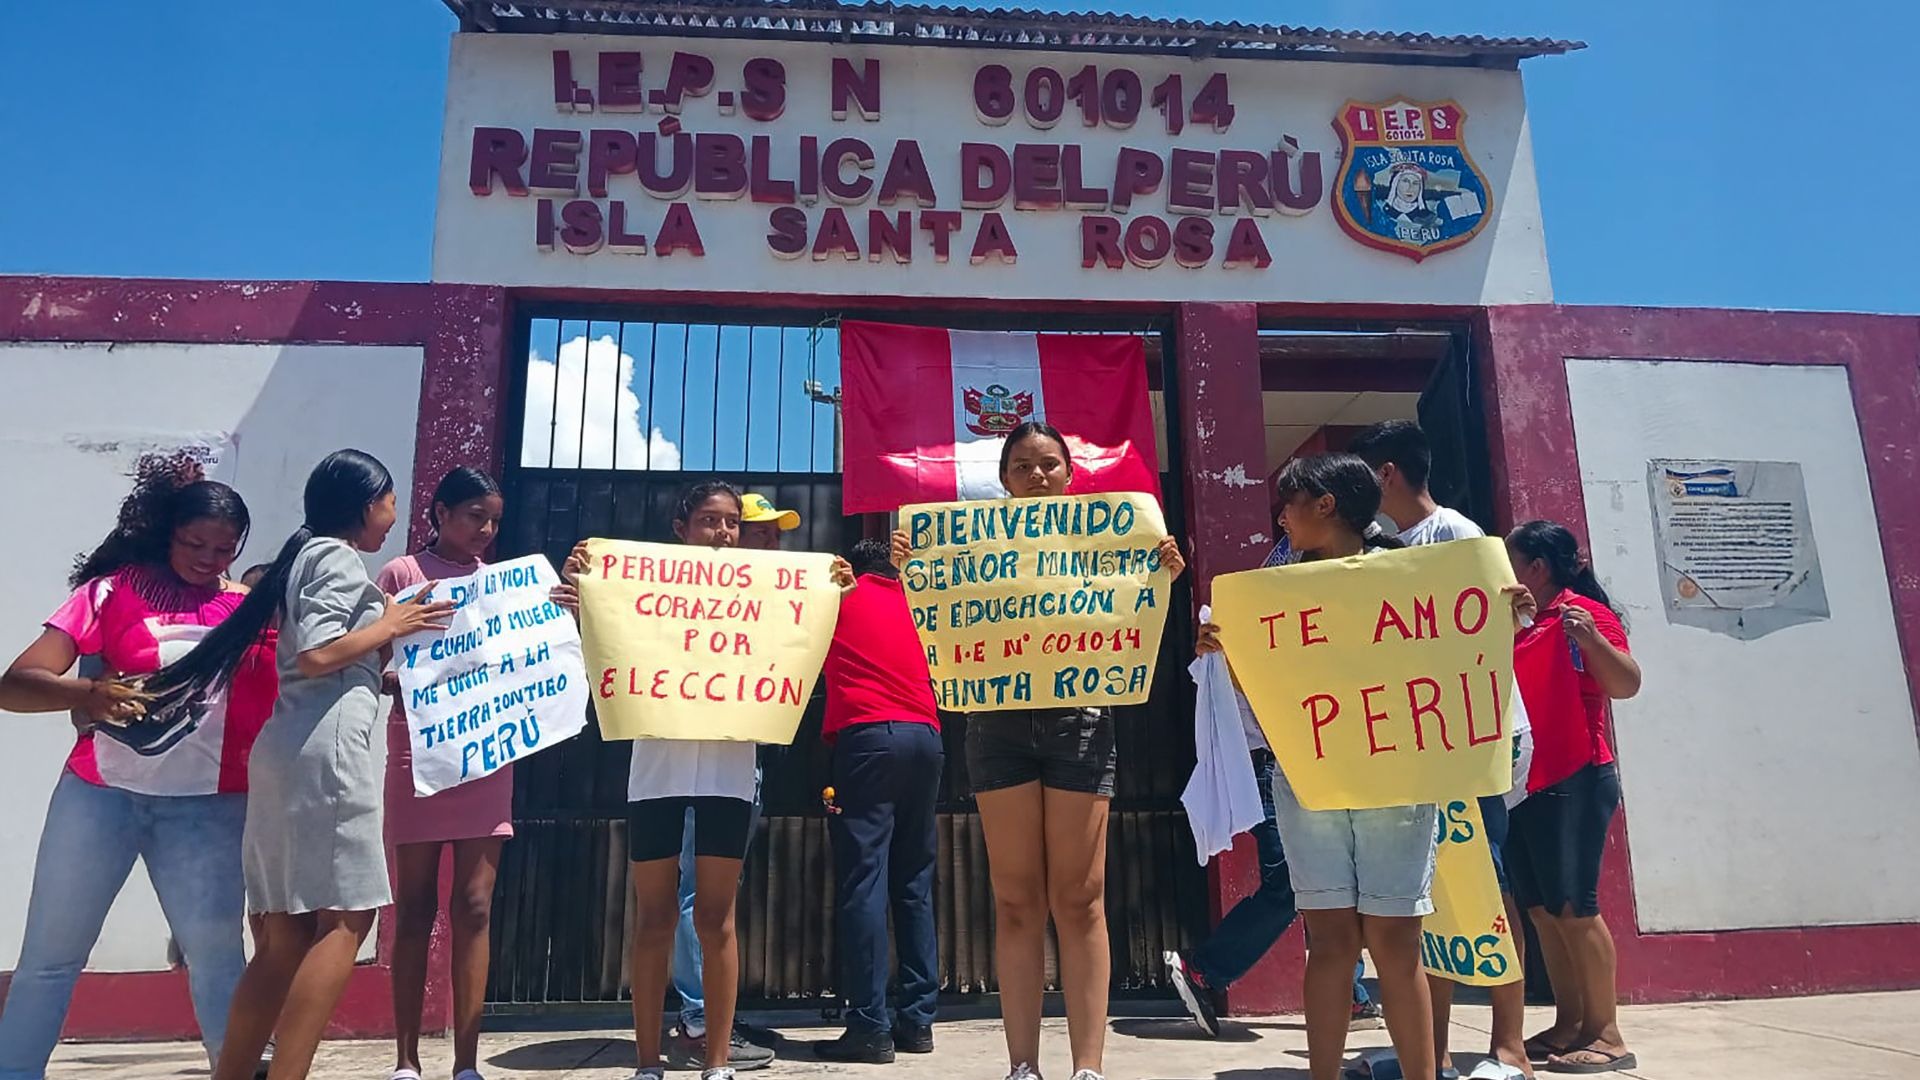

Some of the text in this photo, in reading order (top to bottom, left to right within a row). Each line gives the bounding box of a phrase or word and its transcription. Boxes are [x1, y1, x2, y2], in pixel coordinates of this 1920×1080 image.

[831, 58, 880, 120] N
[974, 64, 1236, 135] 601014
[469, 115, 936, 208] REPÚBLICA
[1364, 153, 1388, 168] ISLA
[1429, 152, 1455, 168] ROSA
[536, 199, 1272, 269] ISLA SANTA ROSA
[911, 501, 1135, 550] BIENVENIDO
[500, 565, 538, 591] VIDA
[602, 555, 808, 590] PERUANOS DE
[905, 548, 1161, 592] SEÑOR MINISTRO
[635, 593, 803, 625] CORAZÓN Y
[950, 578, 1115, 628] EDUCACIÓN
[1135, 587, 1156, 613] A
[1260, 587, 1489, 650] TE AMO
[403, 644, 420, 669] Y
[485, 615, 502, 637] YO
[683, 629, 752, 655] POR
[1042, 628, 1141, 654] 601014
[412, 681, 438, 709] ME
[500, 653, 515, 674] A
[525, 642, 550, 668] LA
[600, 664, 802, 706] ELECCIÓN
[1054, 665, 1147, 699] ROSA
[419, 701, 491, 749] TIERRA
[1301, 653, 1502, 760] PERÚ
[461, 706, 540, 779] PERÚ
[1421, 930, 1507, 978] NOS
